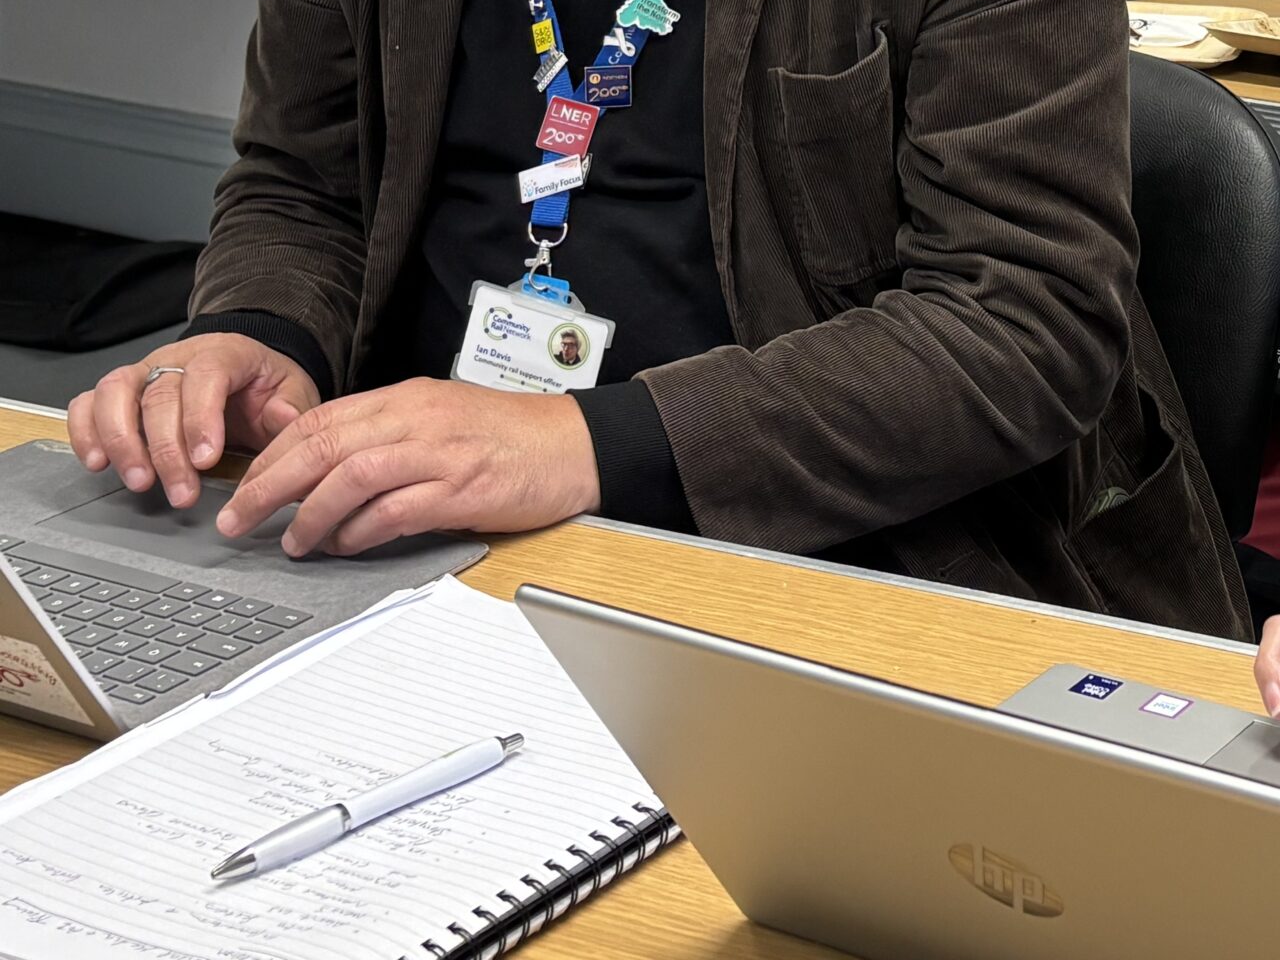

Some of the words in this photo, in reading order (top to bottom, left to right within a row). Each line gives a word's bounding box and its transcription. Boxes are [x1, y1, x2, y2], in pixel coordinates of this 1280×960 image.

[551, 102, 592, 126] LNER
[543, 126, 580, 146] 200
[535, 179, 560, 196] Family
[559, 175, 582, 190] Focus
[490, 321, 504, 332] Rail
[504, 326, 532, 341] Network
[493, 314, 531, 334] Community
[476, 344, 489, 355] Ian
[490, 348, 512, 363] Davis
[473, 354, 508, 372] Community
[508, 365, 519, 375] rail
[519, 371, 543, 383] support
[543, 377, 563, 389] officer
[972, 842, 1048, 916] hp
